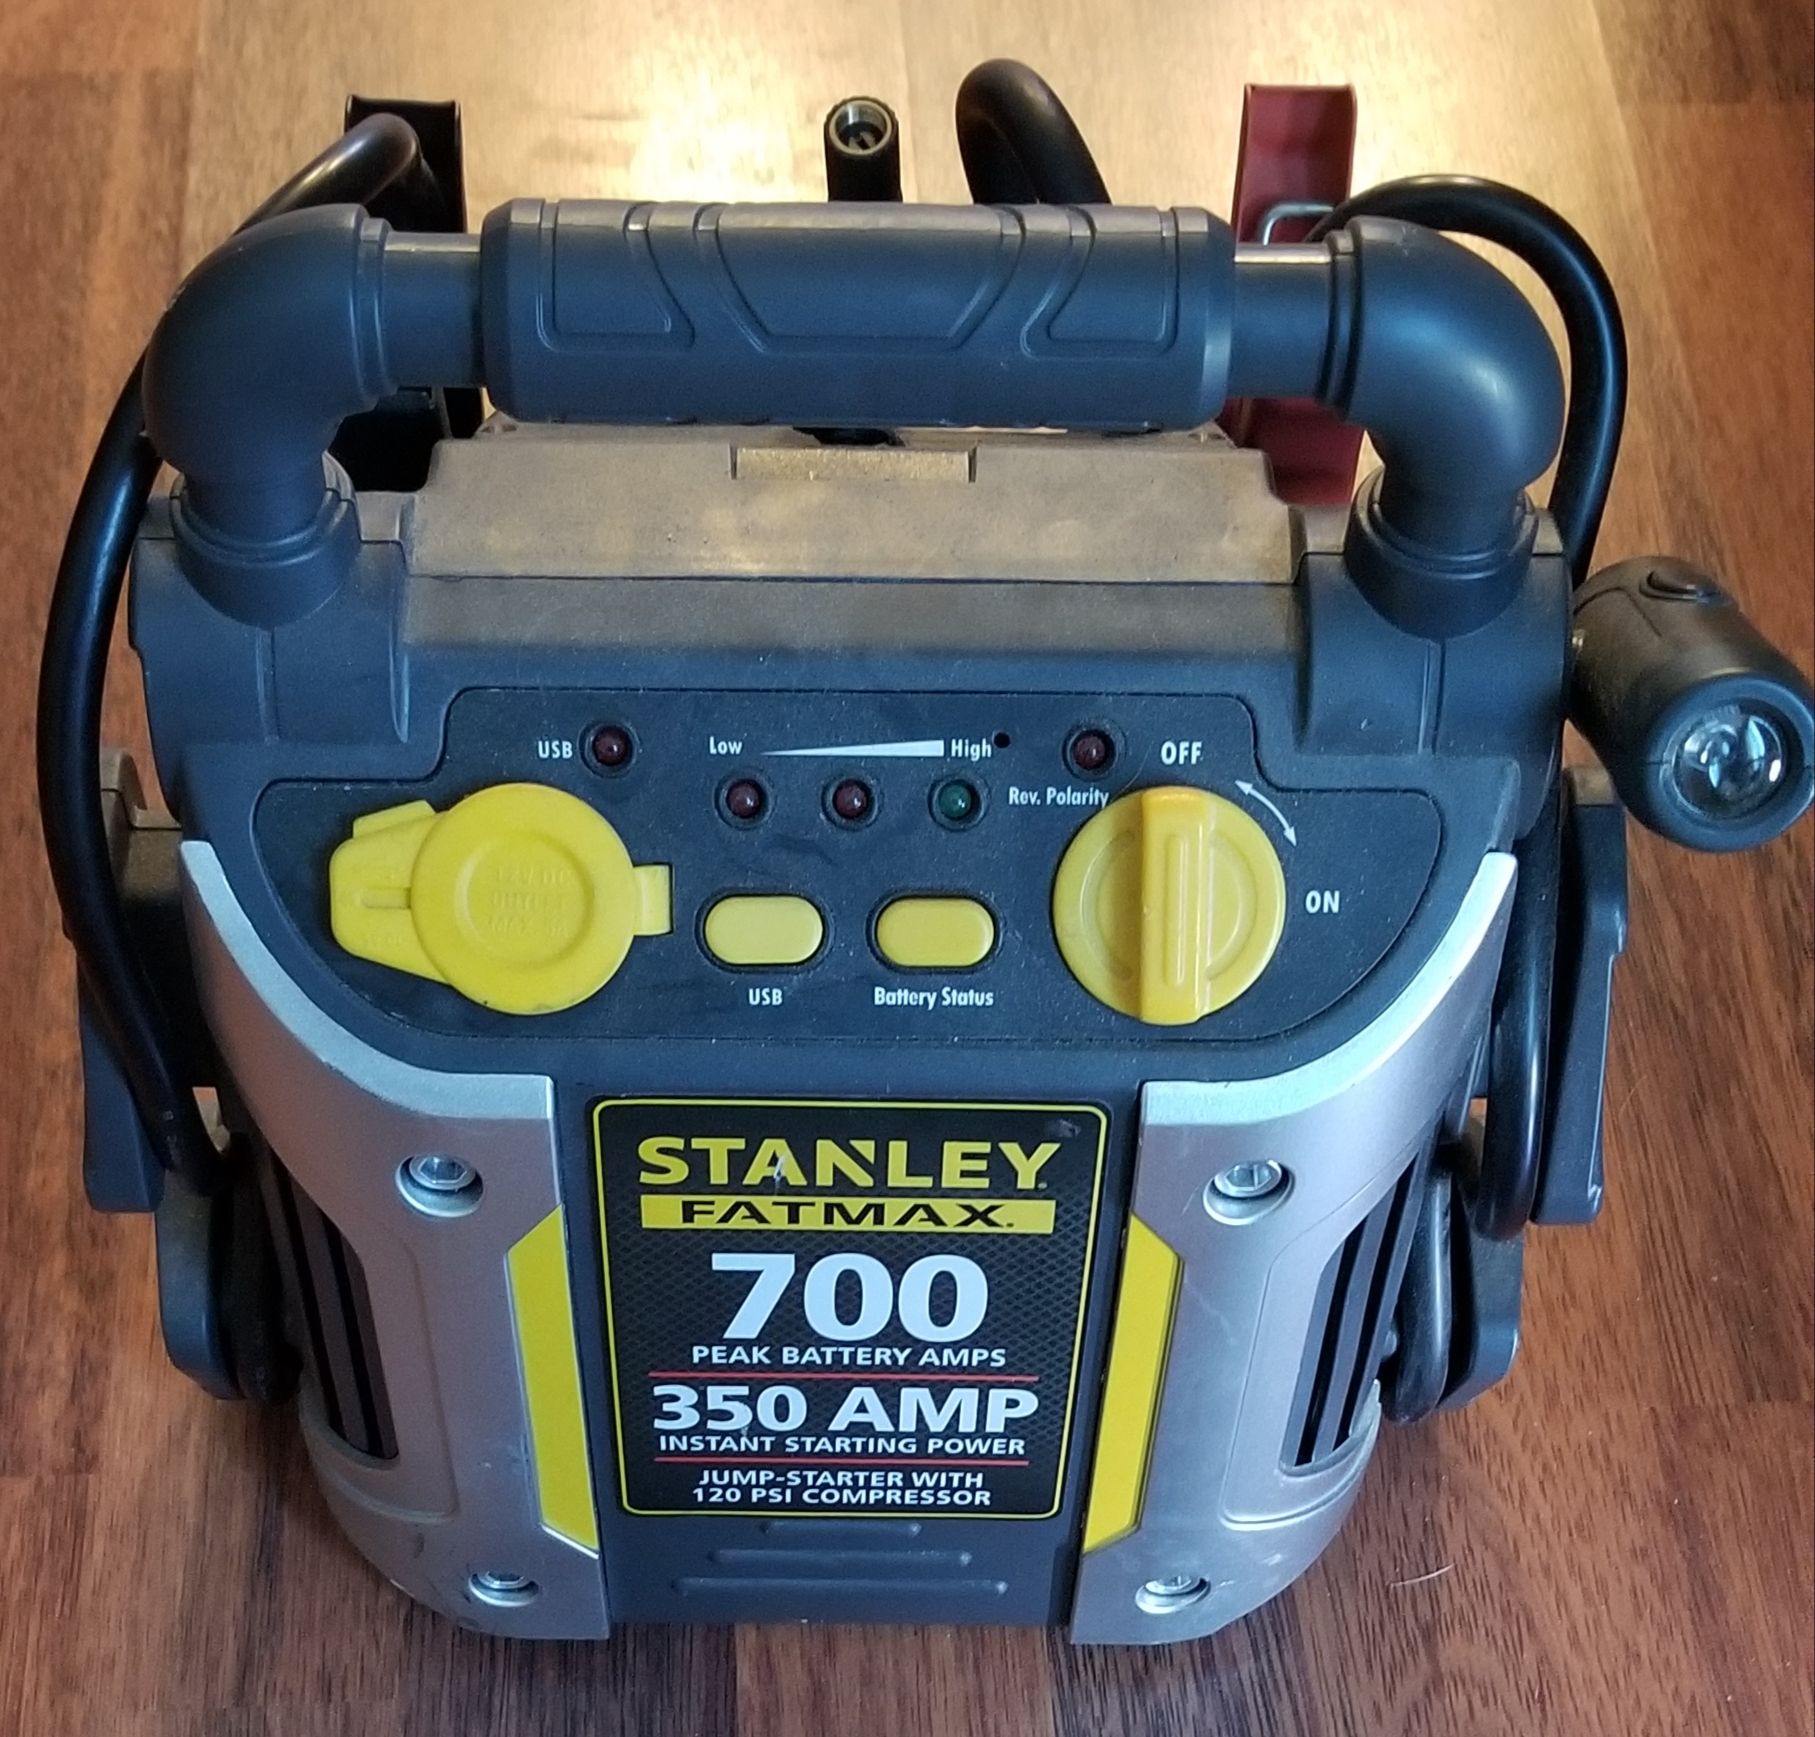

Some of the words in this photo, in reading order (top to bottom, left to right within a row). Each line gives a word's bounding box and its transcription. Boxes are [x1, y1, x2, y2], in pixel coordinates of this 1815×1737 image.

[538, 740, 573, 760] USB
[709, 736, 743, 755] Low
[950, 739, 992, 760] High
[1160, 741, 1202, 765] OFF
[1008, 786, 1041, 806] Rev.
[1046, 786, 1109, 810] Polarity
[1305, 890, 1340, 914] ON
[748, 987, 783, 1007] USB
[874, 986, 937, 1011] Battery
[941, 986, 994, 1007] Status
[638, 1137, 1061, 1190] STANLEY
[682, 1200, 1005, 1228] FATMAX
[711, 1252, 989, 1343] 700
[692, 1345, 771, 1364] PEAK
[782, 1346, 911, 1366] BATTERY
[919, 1348, 1006, 1367] AMPS
[653, 1384, 807, 1432] 350
[827, 1386, 1039, 1433] AMP
[660, 1435, 773, 1453] INSTANT
[785, 1436, 918, 1454] STARTING
[927, 1438, 1025, 1455] POWER
[699, 1470, 905, 1488] JUMP-STARTER
[912, 1471, 984, 1488] WITH
[693, 1487, 742, 1503] 120
[751, 1487, 792, 1503] PSI
[802, 1488, 991, 1506] COMPRESSOR
